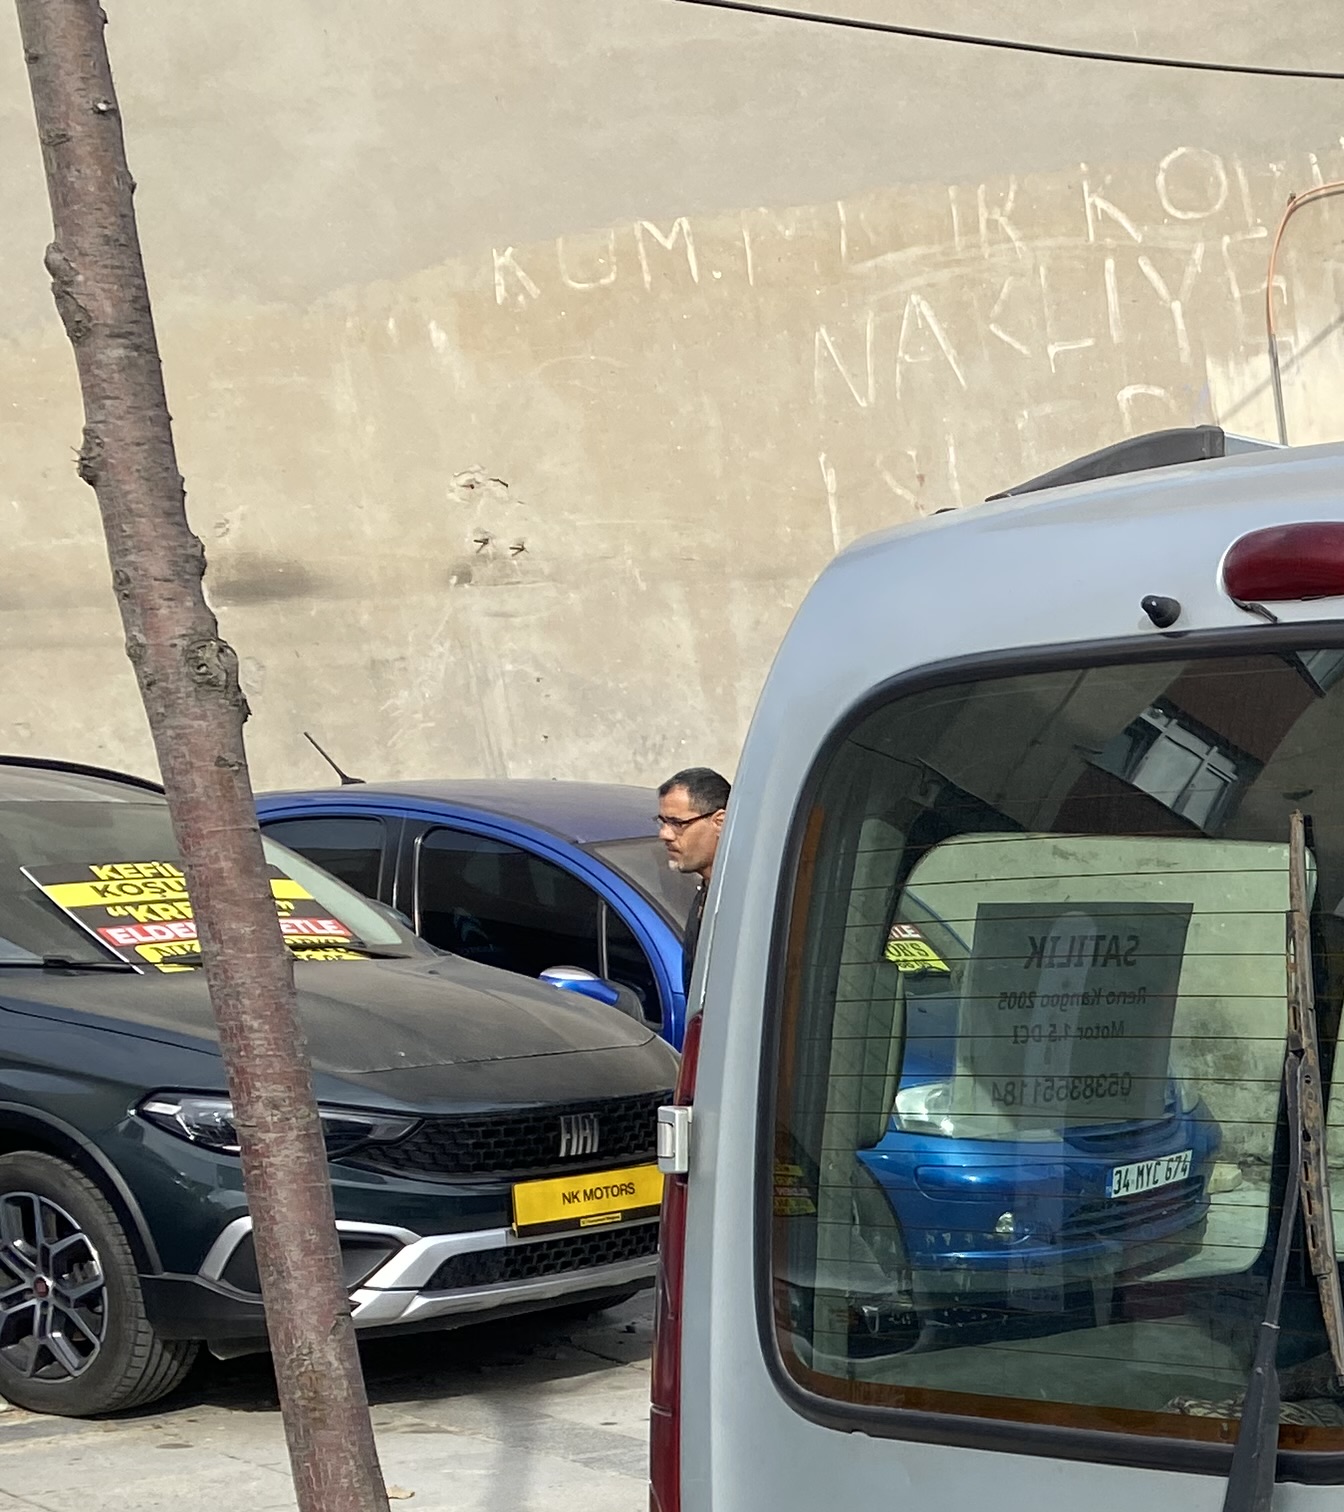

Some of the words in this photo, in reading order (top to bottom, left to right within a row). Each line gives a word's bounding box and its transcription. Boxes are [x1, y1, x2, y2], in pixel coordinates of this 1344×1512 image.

[561, 1190, 582, 1206] NK
[583, 1182, 636, 1203] MOTORS
[1113, 1167, 1130, 1195] 34
